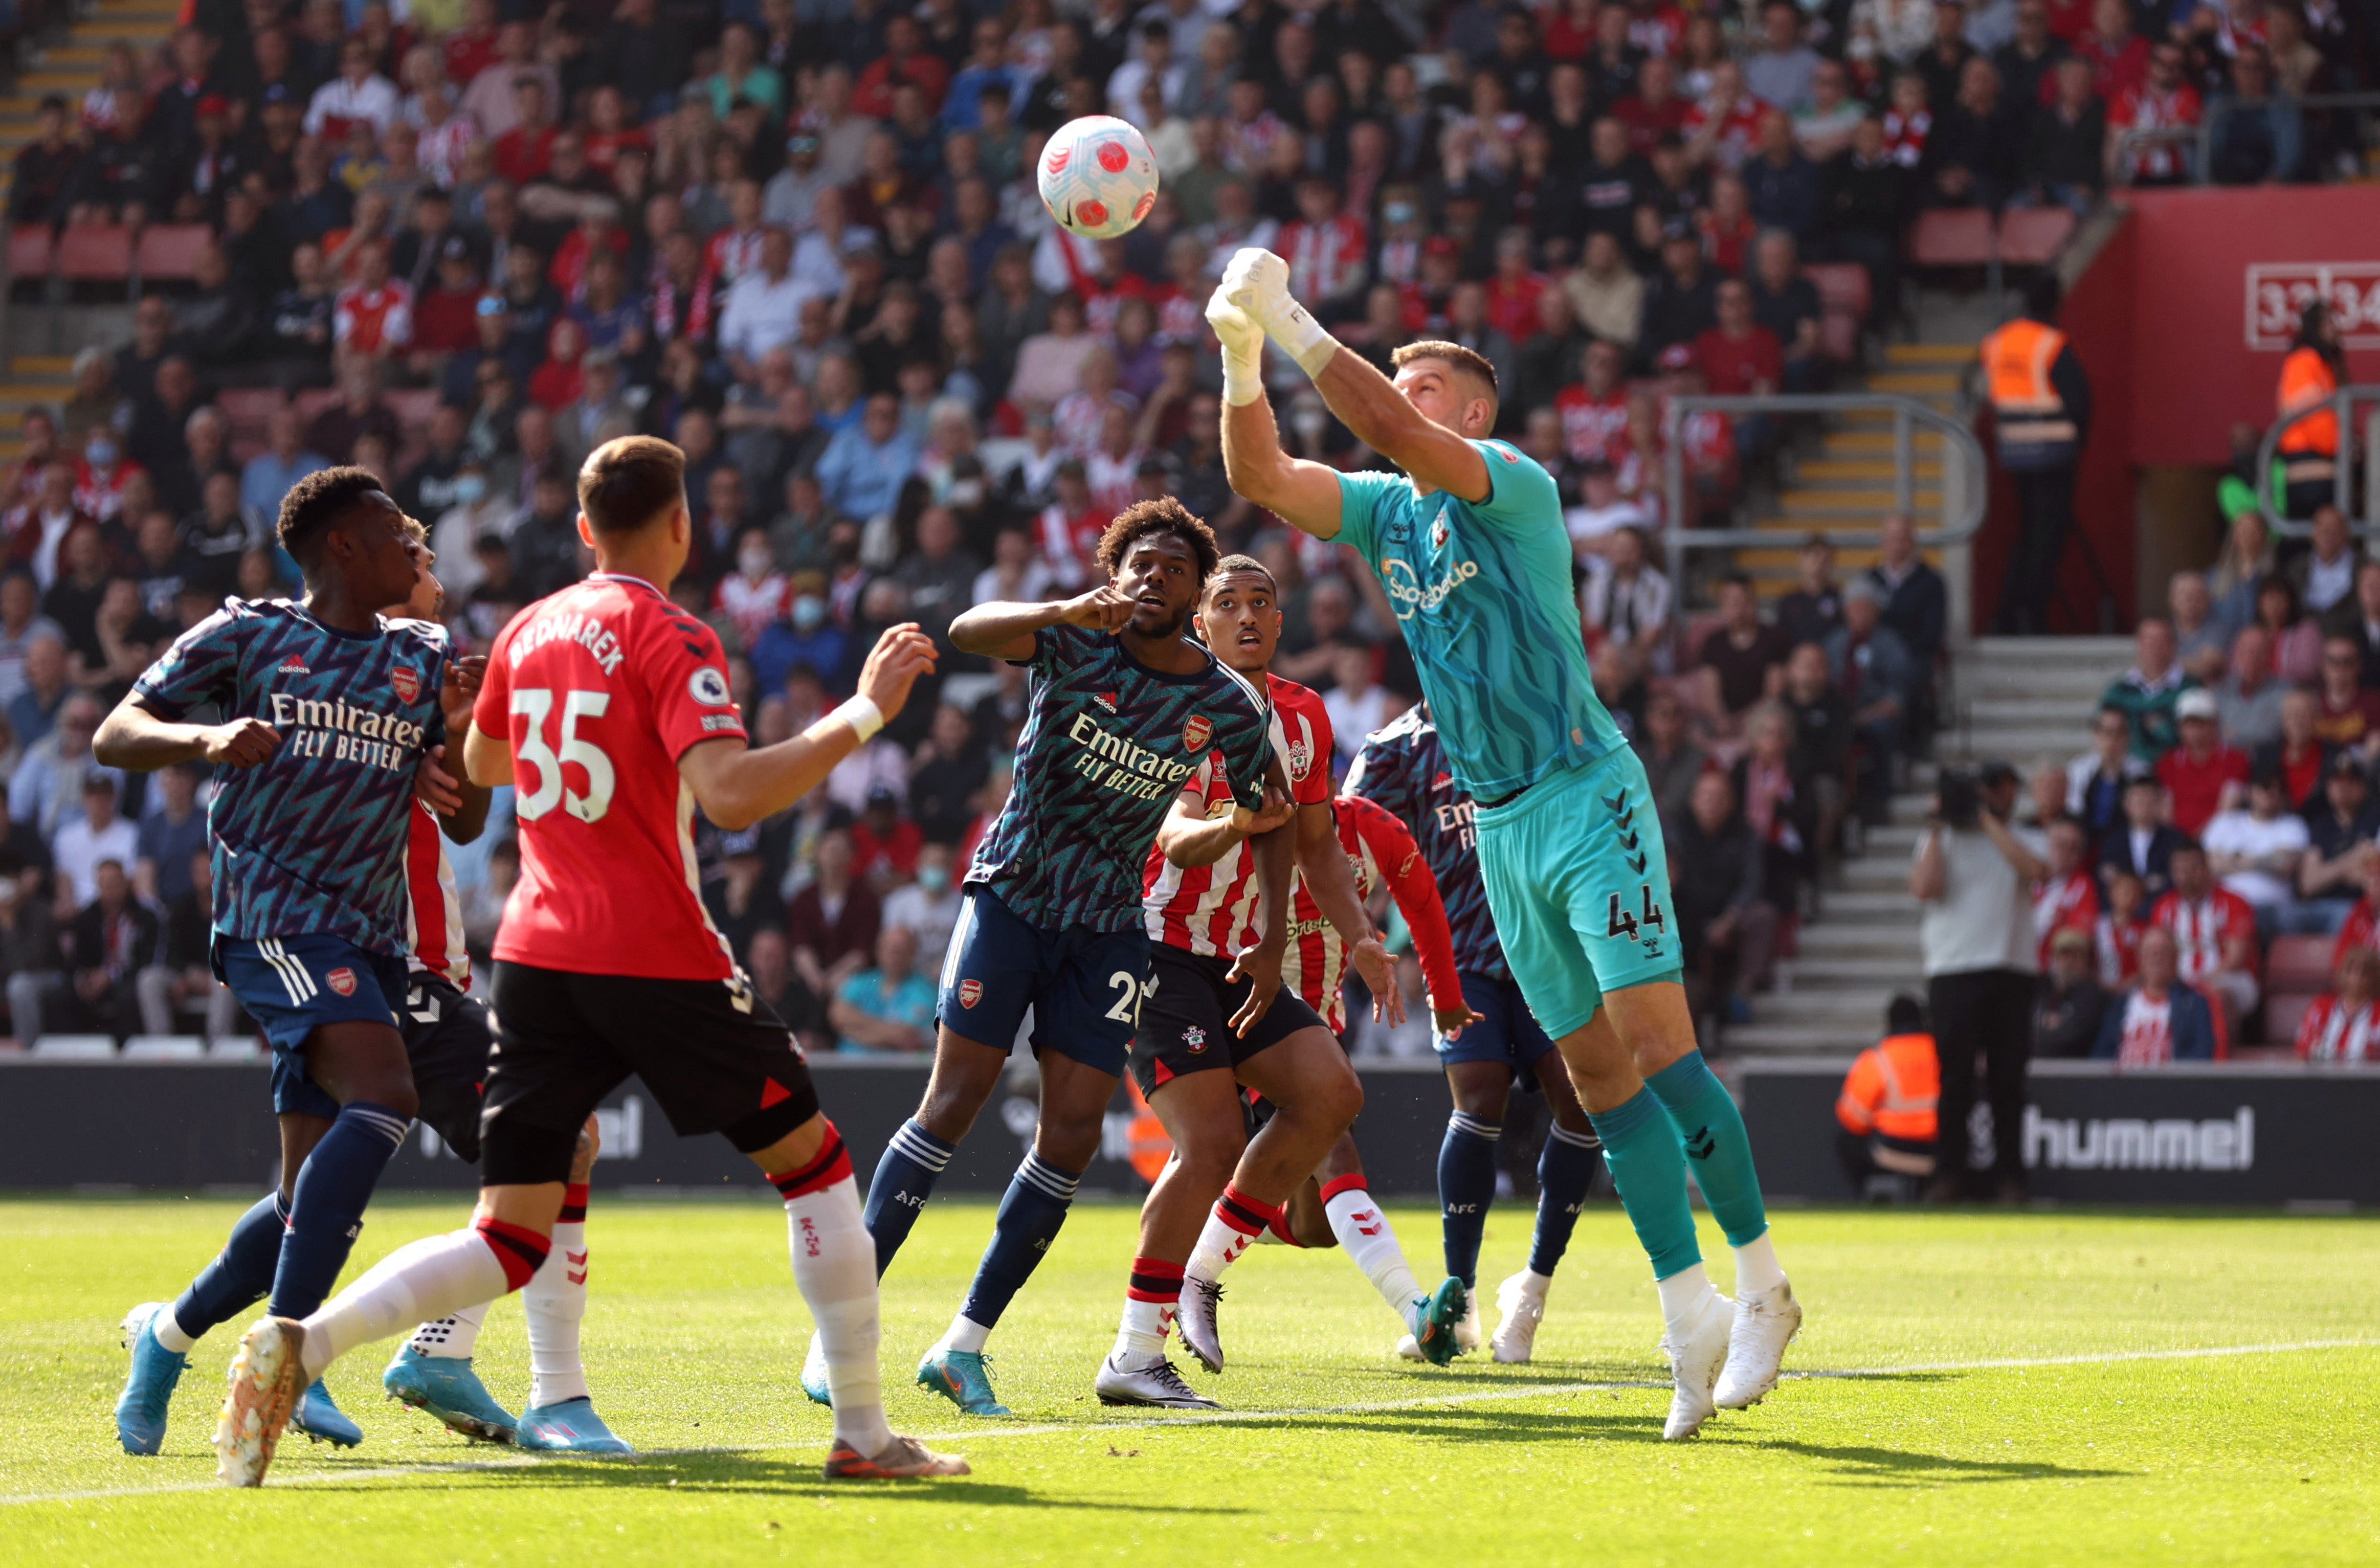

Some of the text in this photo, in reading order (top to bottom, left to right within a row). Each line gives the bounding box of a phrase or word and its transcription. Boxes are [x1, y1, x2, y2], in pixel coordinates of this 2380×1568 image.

[509, 613, 625, 678] BEDNAREK
[278, 665, 310, 675] adidas
[393, 670, 417, 682] Arsenal
[270, 692, 425, 748] Emirates
[1093, 695, 1118, 714] adidas
[1189, 719, 1210, 732] Arsenal
[292, 729, 403, 772] FLY BETTER
[508, 688, 616, 824] 35
[1074, 753, 1166, 801] FLY BETTER
[1608, 884, 1665, 943] 44
[2021, 1103, 2254, 1171] hummel
[894, 1190, 926, 1211] AFC
[1448, 1202, 1477, 1215] AFC
